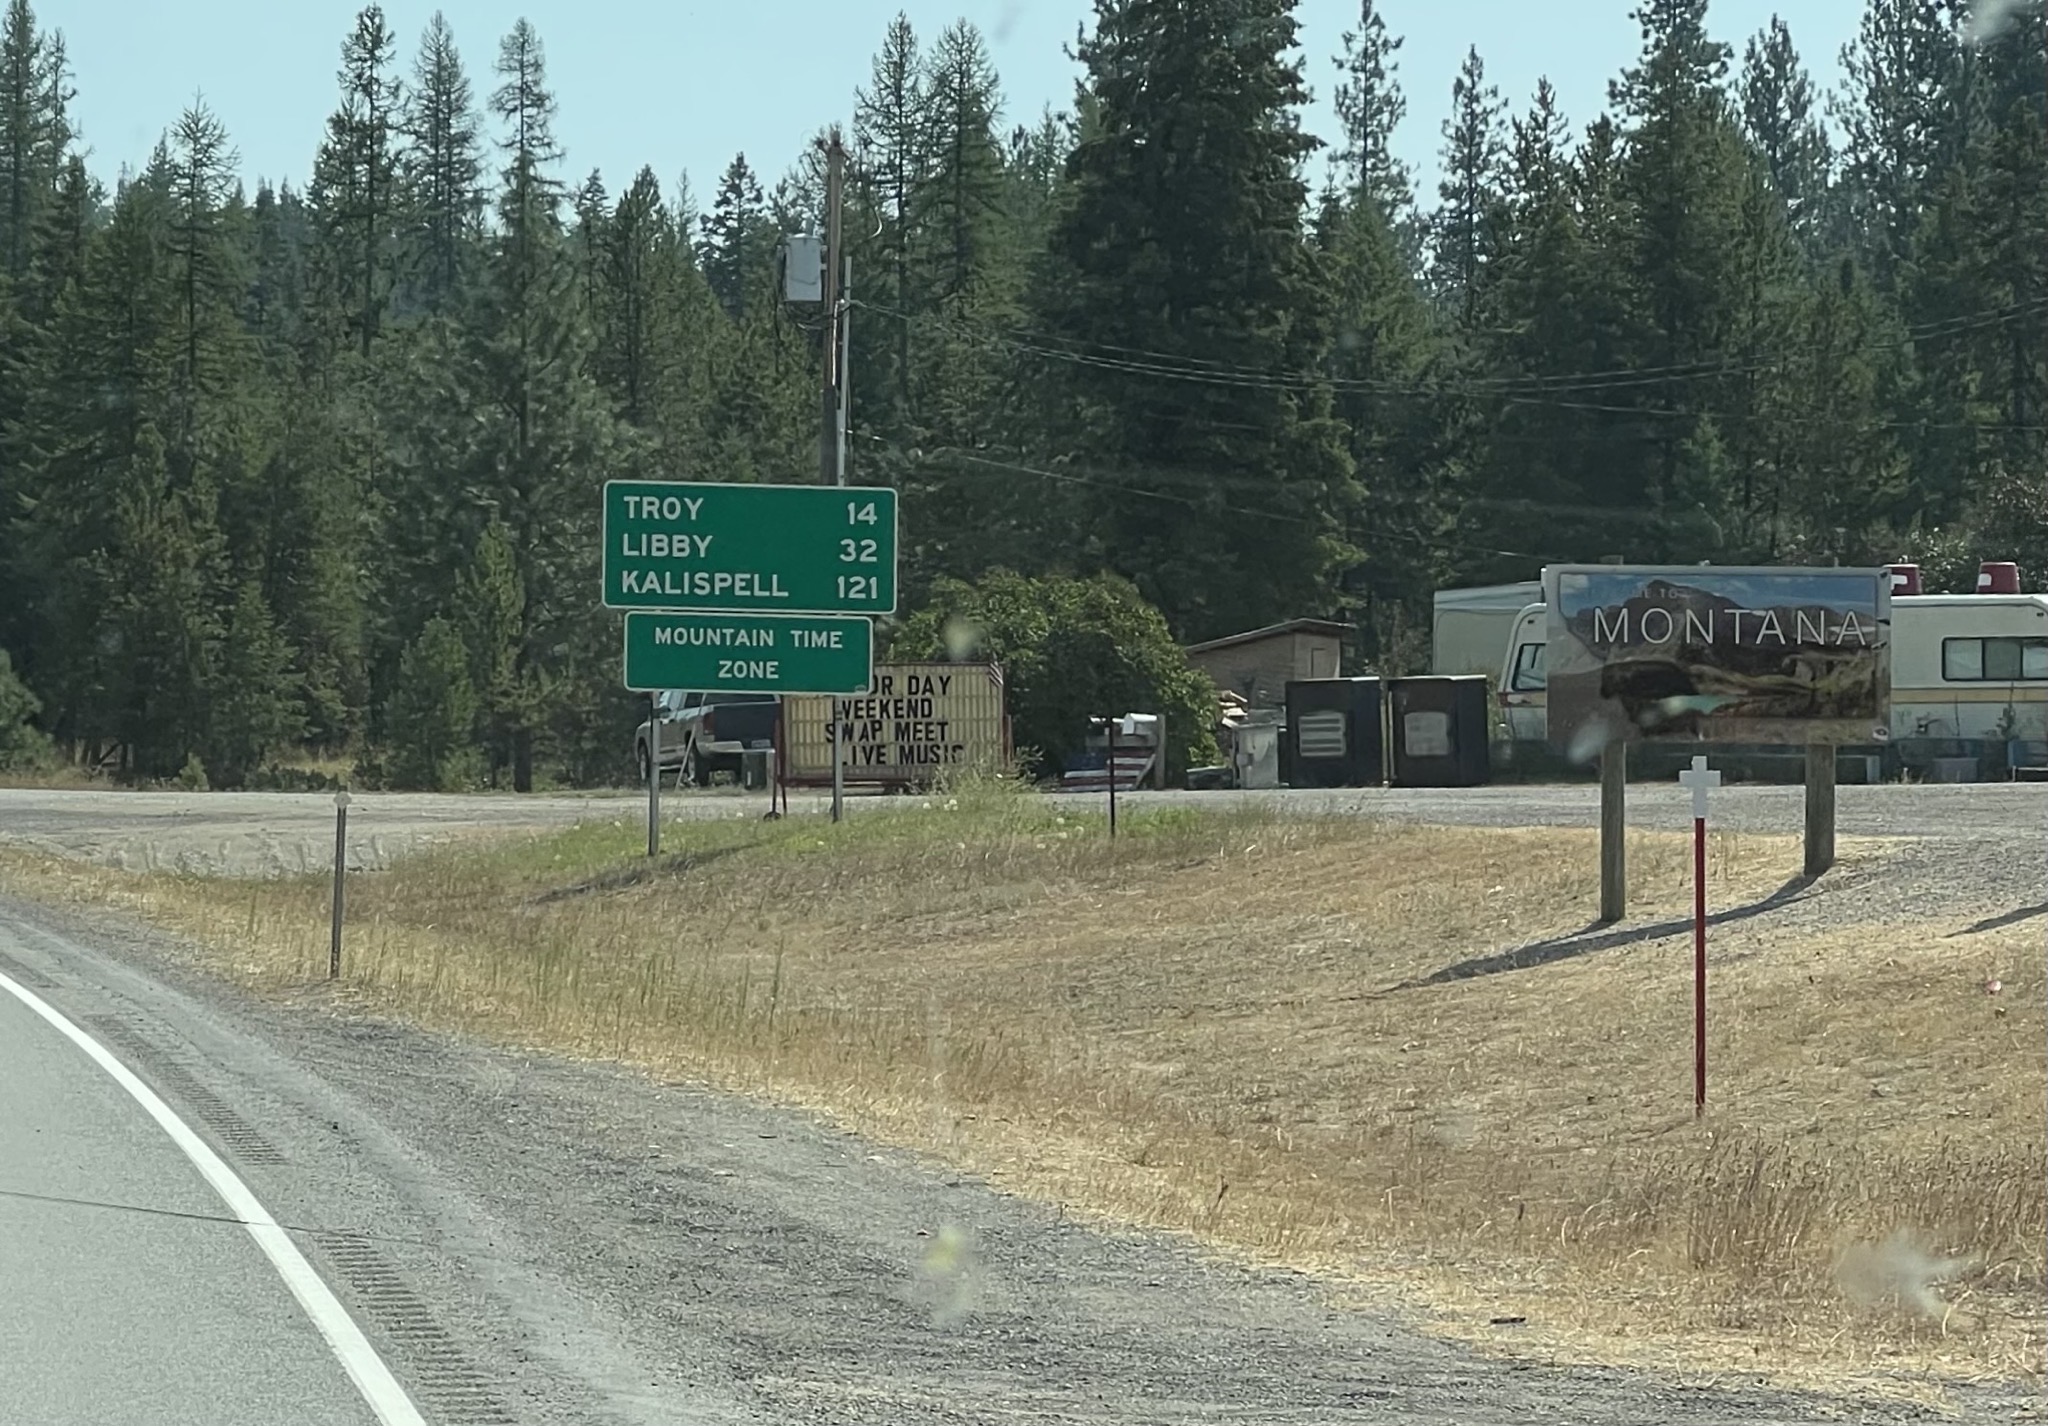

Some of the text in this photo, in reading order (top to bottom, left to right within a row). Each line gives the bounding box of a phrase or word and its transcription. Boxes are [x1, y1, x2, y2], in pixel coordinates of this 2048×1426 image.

[623, 496, 878, 525] TROY 14
[622, 533, 878, 562] LIBBY 32
[621, 570, 878, 599] KALISPELL 121
[1593, 608, 1866, 645] MONTANA
[654, 627, 843, 649] MOUNTAIN TIME
[718, 660, 779, 679] ZONE
[907, 675, 952, 696] DAY
[894, 721, 949, 743] MEET
[842, 745, 887, 765] IVE
